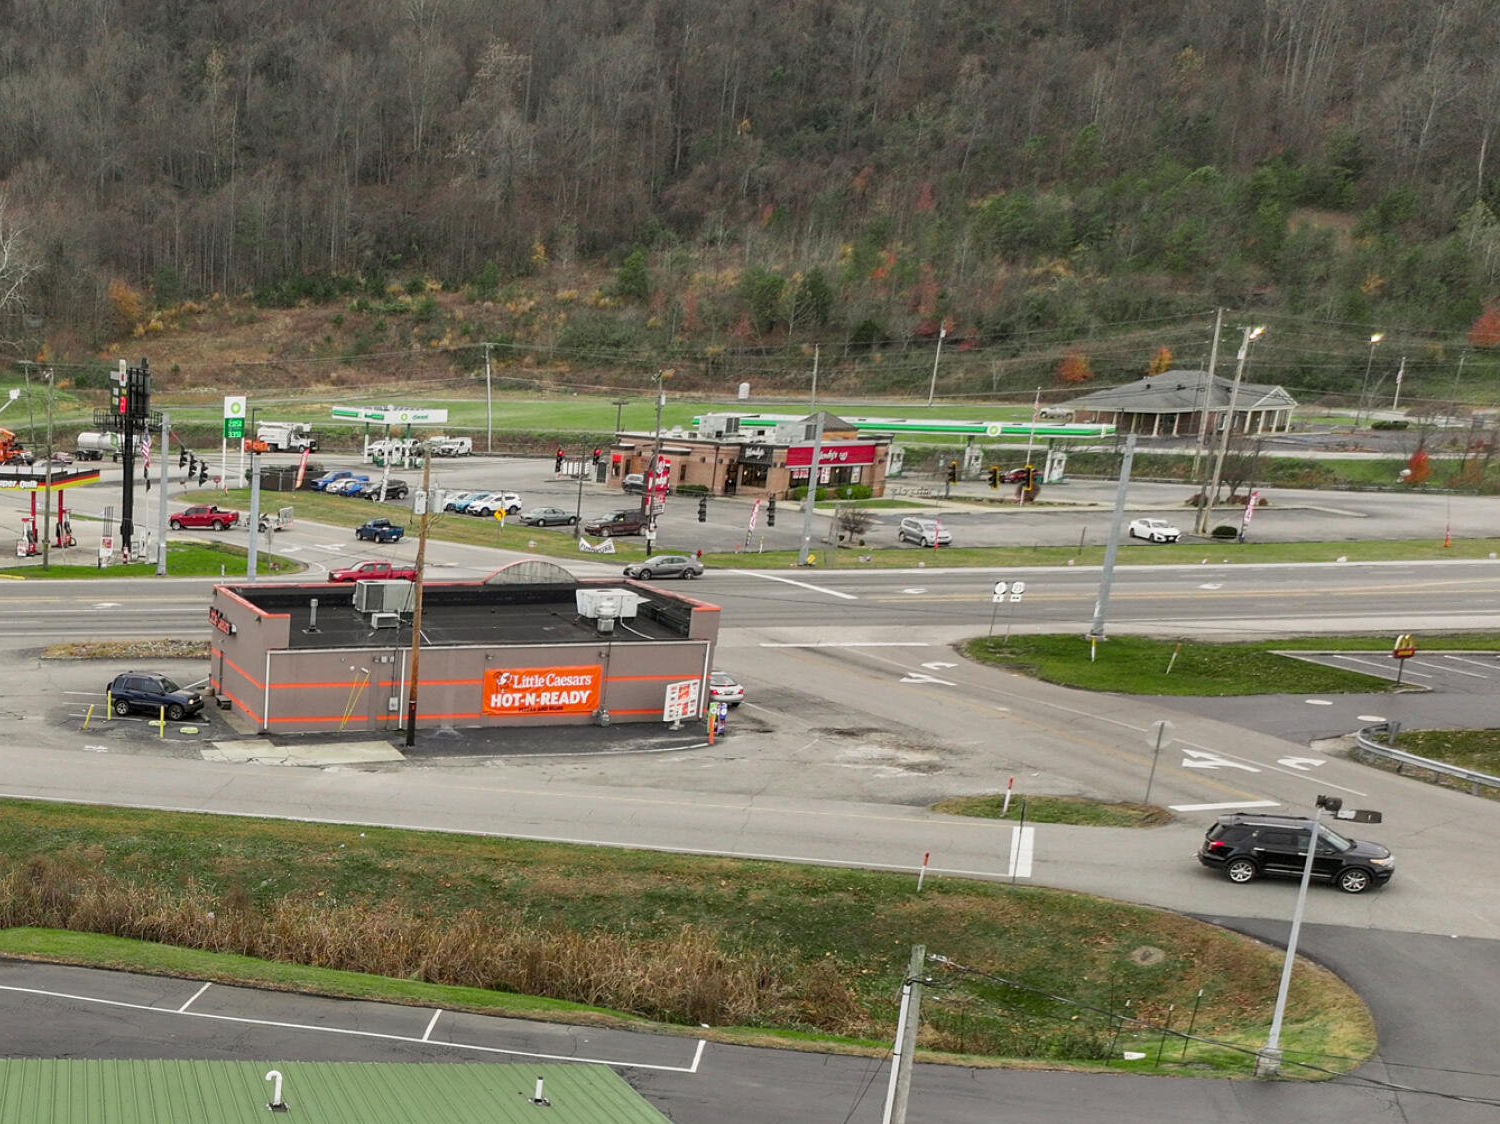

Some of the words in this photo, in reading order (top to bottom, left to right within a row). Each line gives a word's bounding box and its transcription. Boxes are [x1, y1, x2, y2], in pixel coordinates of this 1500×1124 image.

[513, 674, 544, 689] Little
[545, 673, 593, 687] Caesars
[490, 690, 591, 707] HOT-N-READY
